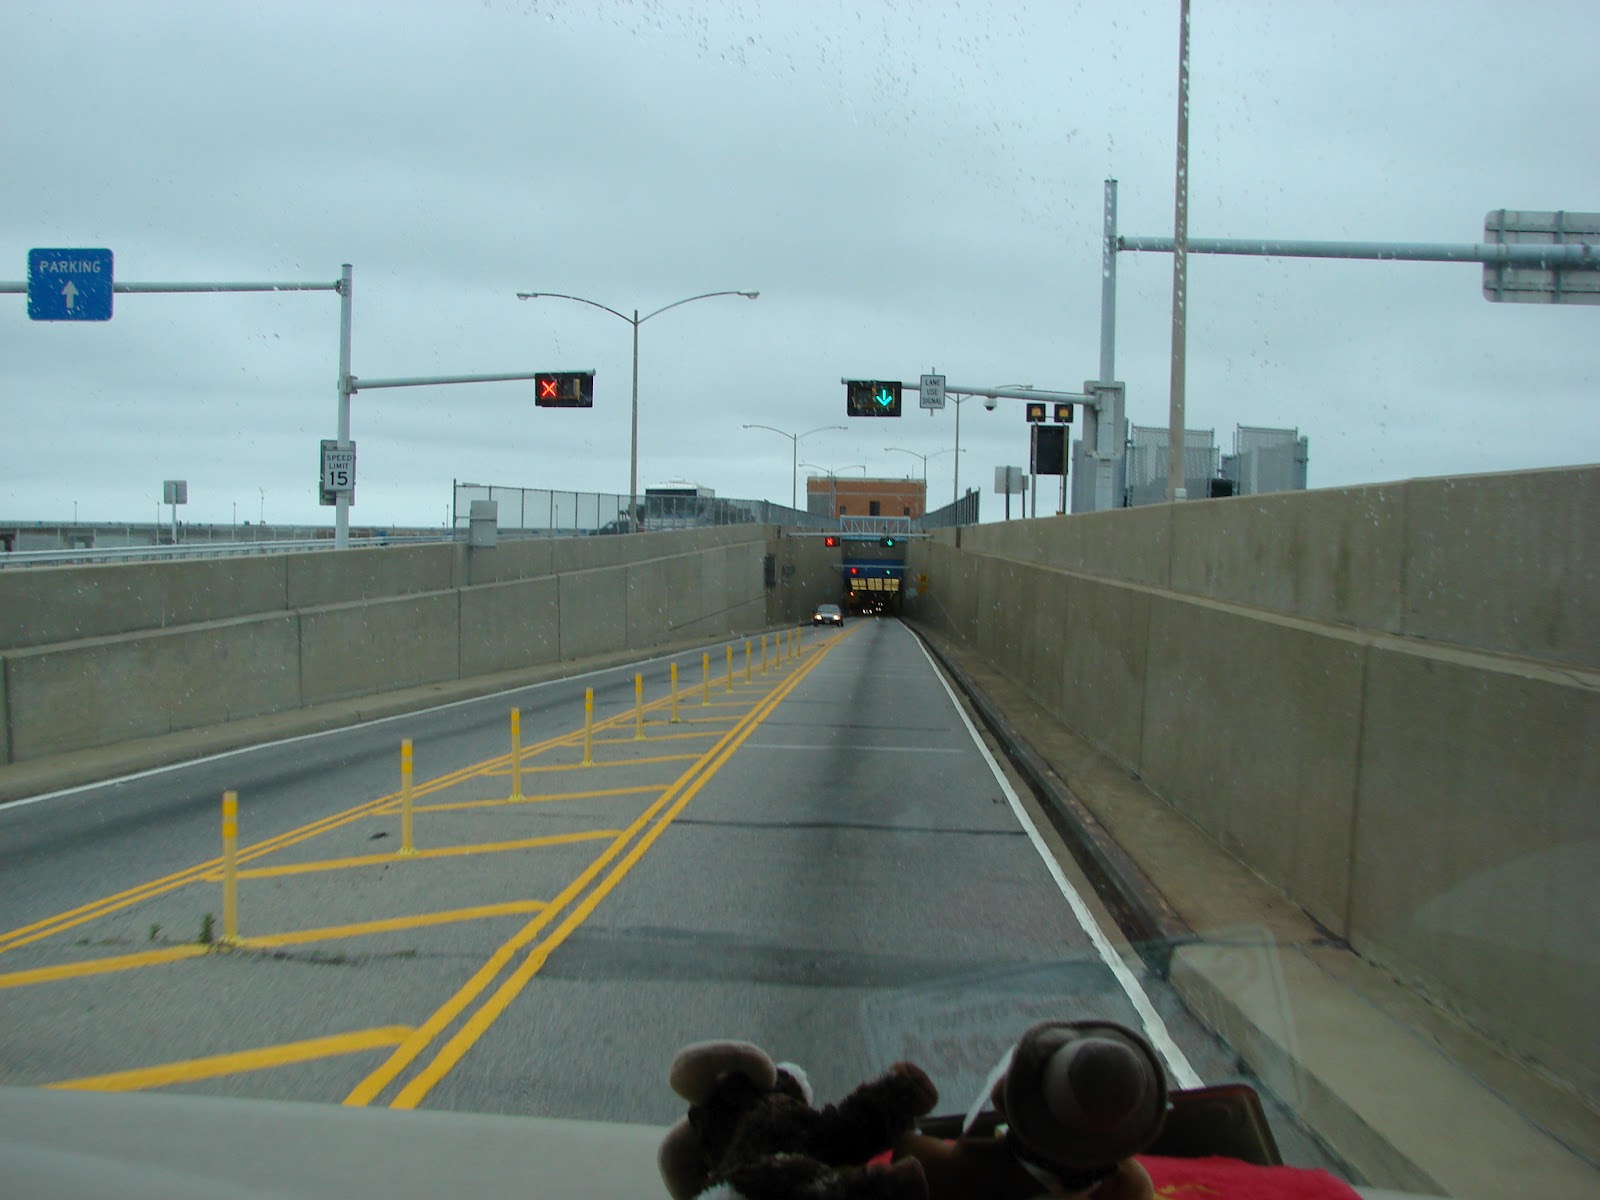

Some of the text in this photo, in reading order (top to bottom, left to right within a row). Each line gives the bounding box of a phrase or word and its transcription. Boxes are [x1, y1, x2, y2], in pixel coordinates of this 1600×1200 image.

[40, 261, 101, 273] PARKING
[922, 397, 942, 405] SIGNAL
[330, 471, 348, 486] 15
